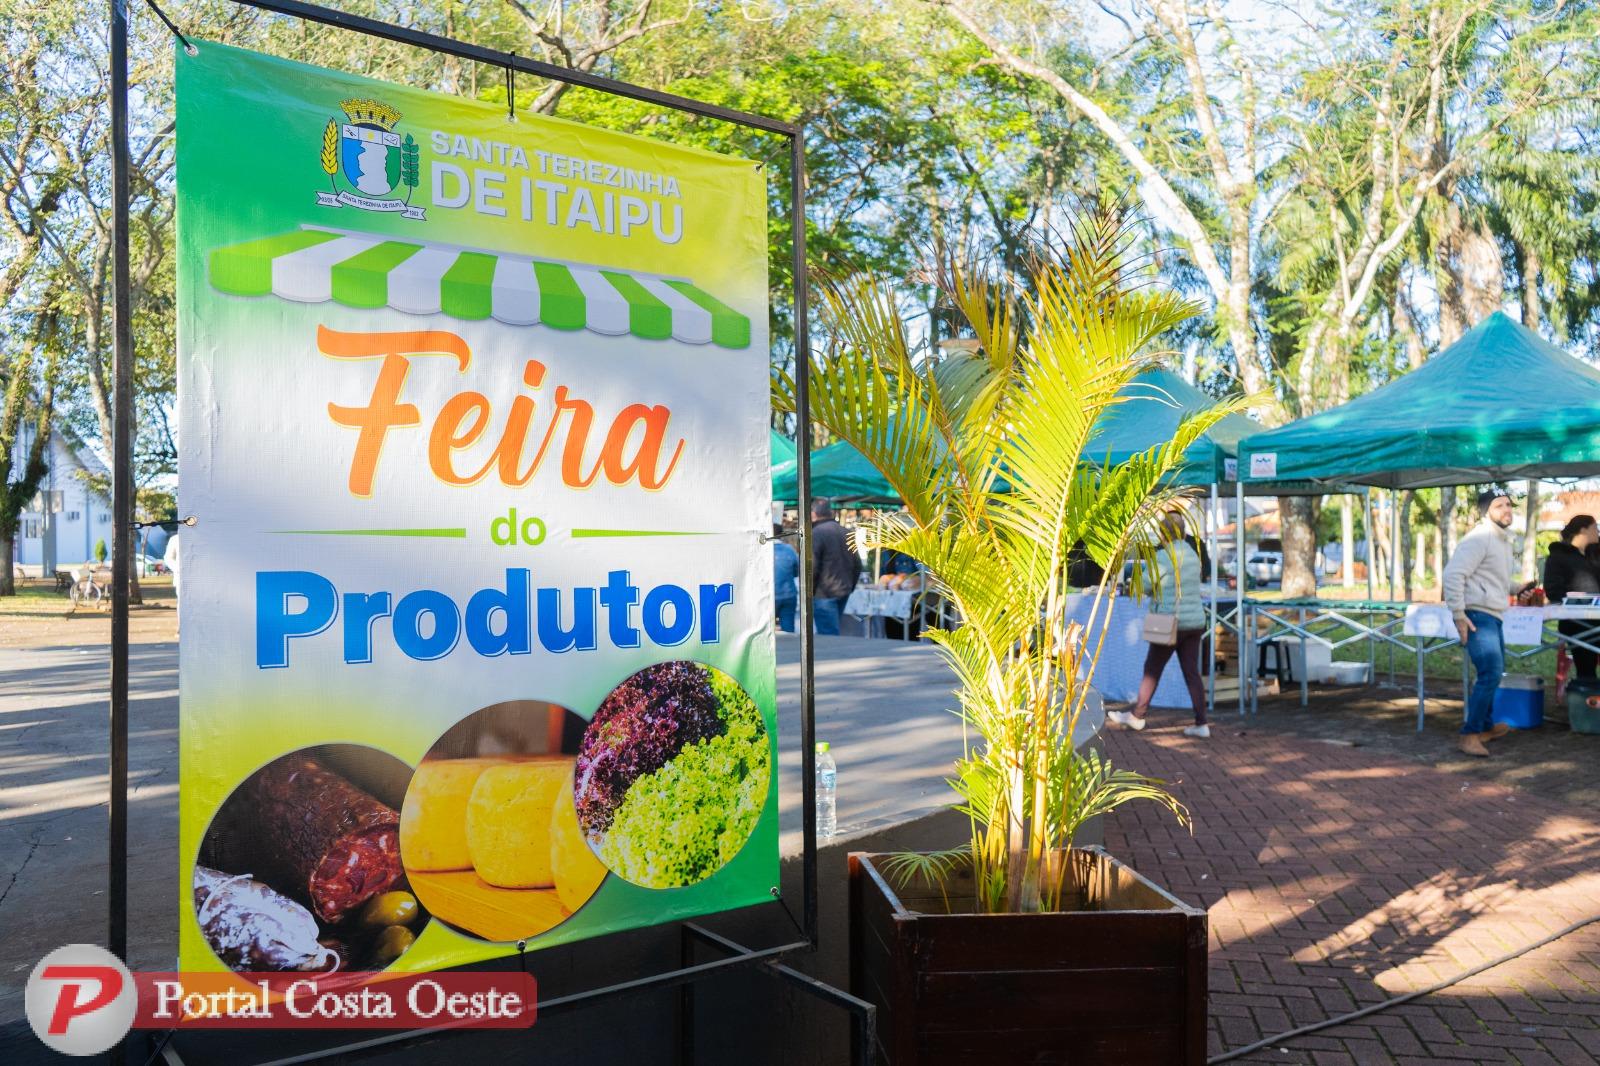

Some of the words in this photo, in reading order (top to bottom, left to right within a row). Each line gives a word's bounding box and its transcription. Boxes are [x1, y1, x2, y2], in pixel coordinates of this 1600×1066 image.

[431, 130, 529, 171] SANTA
[534, 150, 682, 199] TEREZINHA
[431, 160, 507, 217] DE
[520, 176, 683, 245] ITAIPU
[317, 323, 685, 500] Feira
[490, 507, 547, 546] do
[256, 567, 733, 669] Produtor
